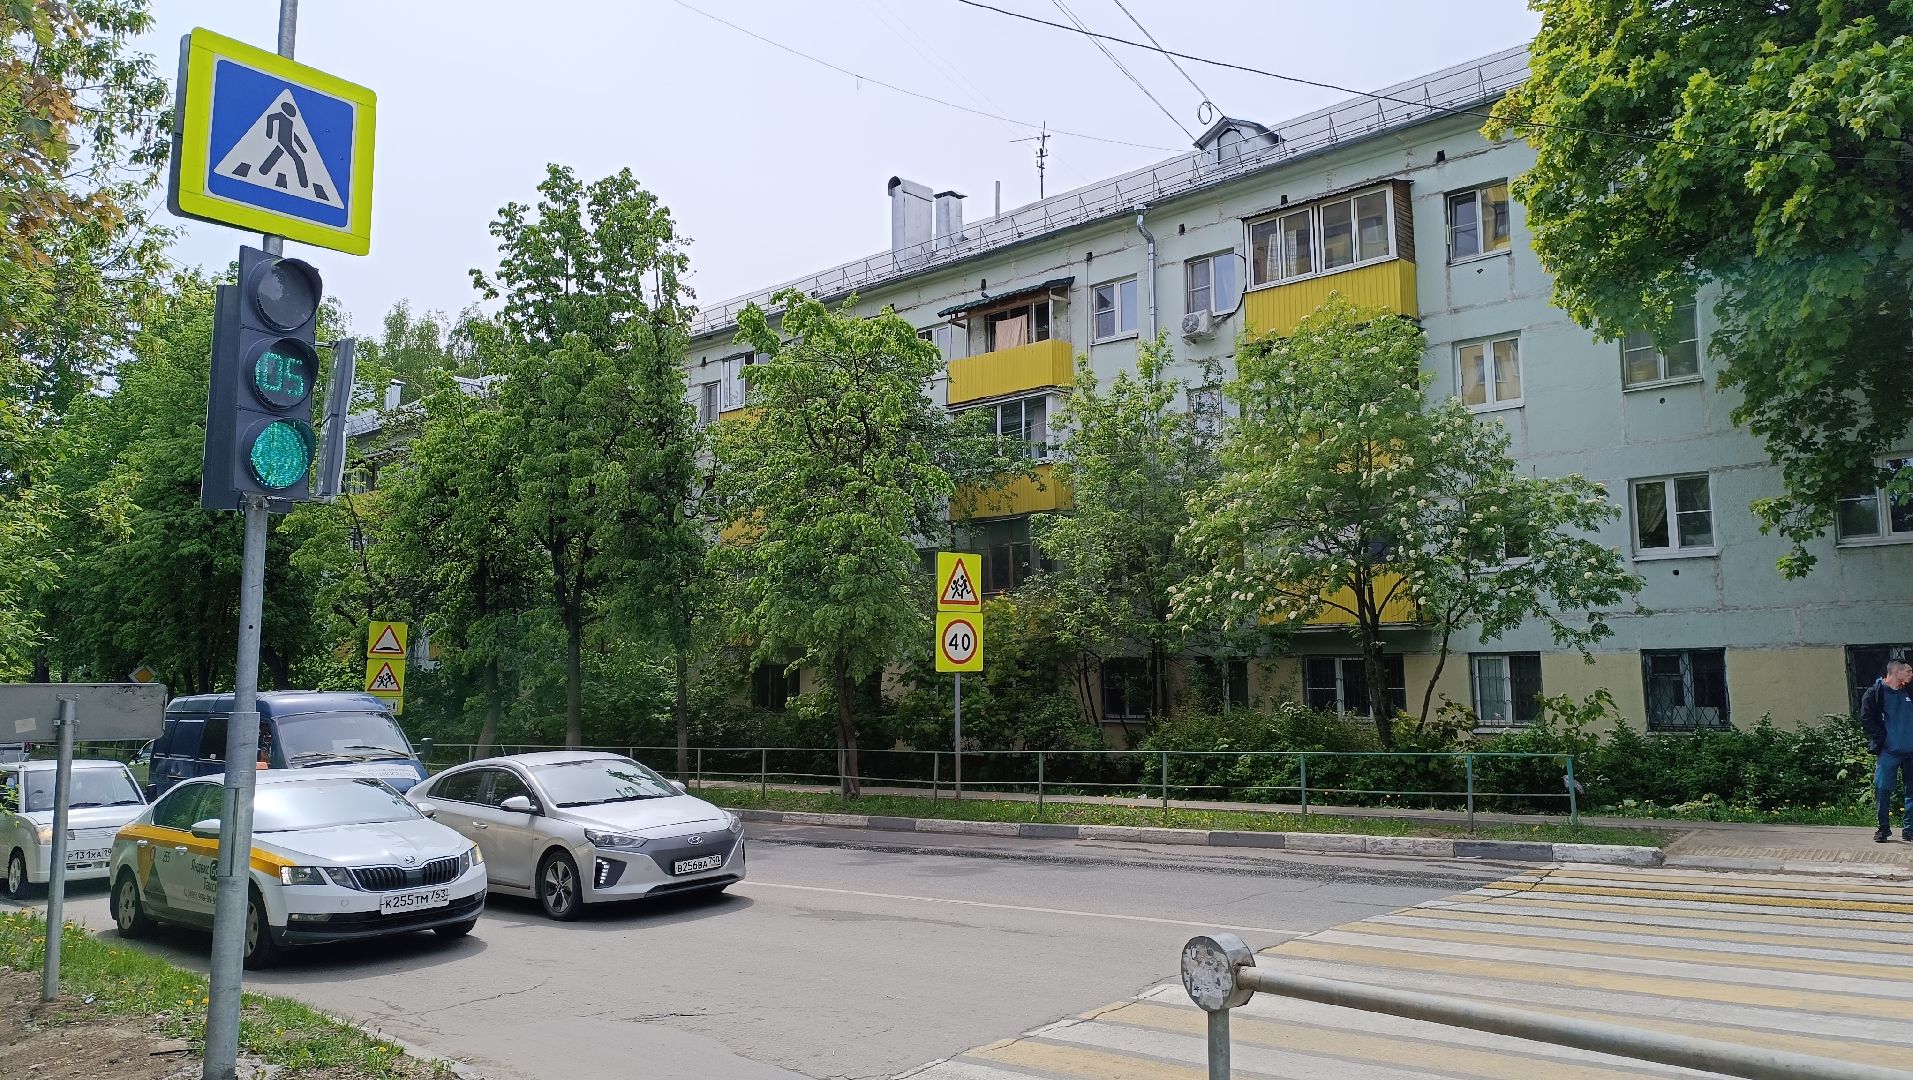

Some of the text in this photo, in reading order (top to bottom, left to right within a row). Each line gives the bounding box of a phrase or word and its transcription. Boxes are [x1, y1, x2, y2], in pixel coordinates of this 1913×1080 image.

[255, 351, 304, 396] 05
[948, 633, 971, 652] 40
[385, 894, 429, 909] К255ТМ
